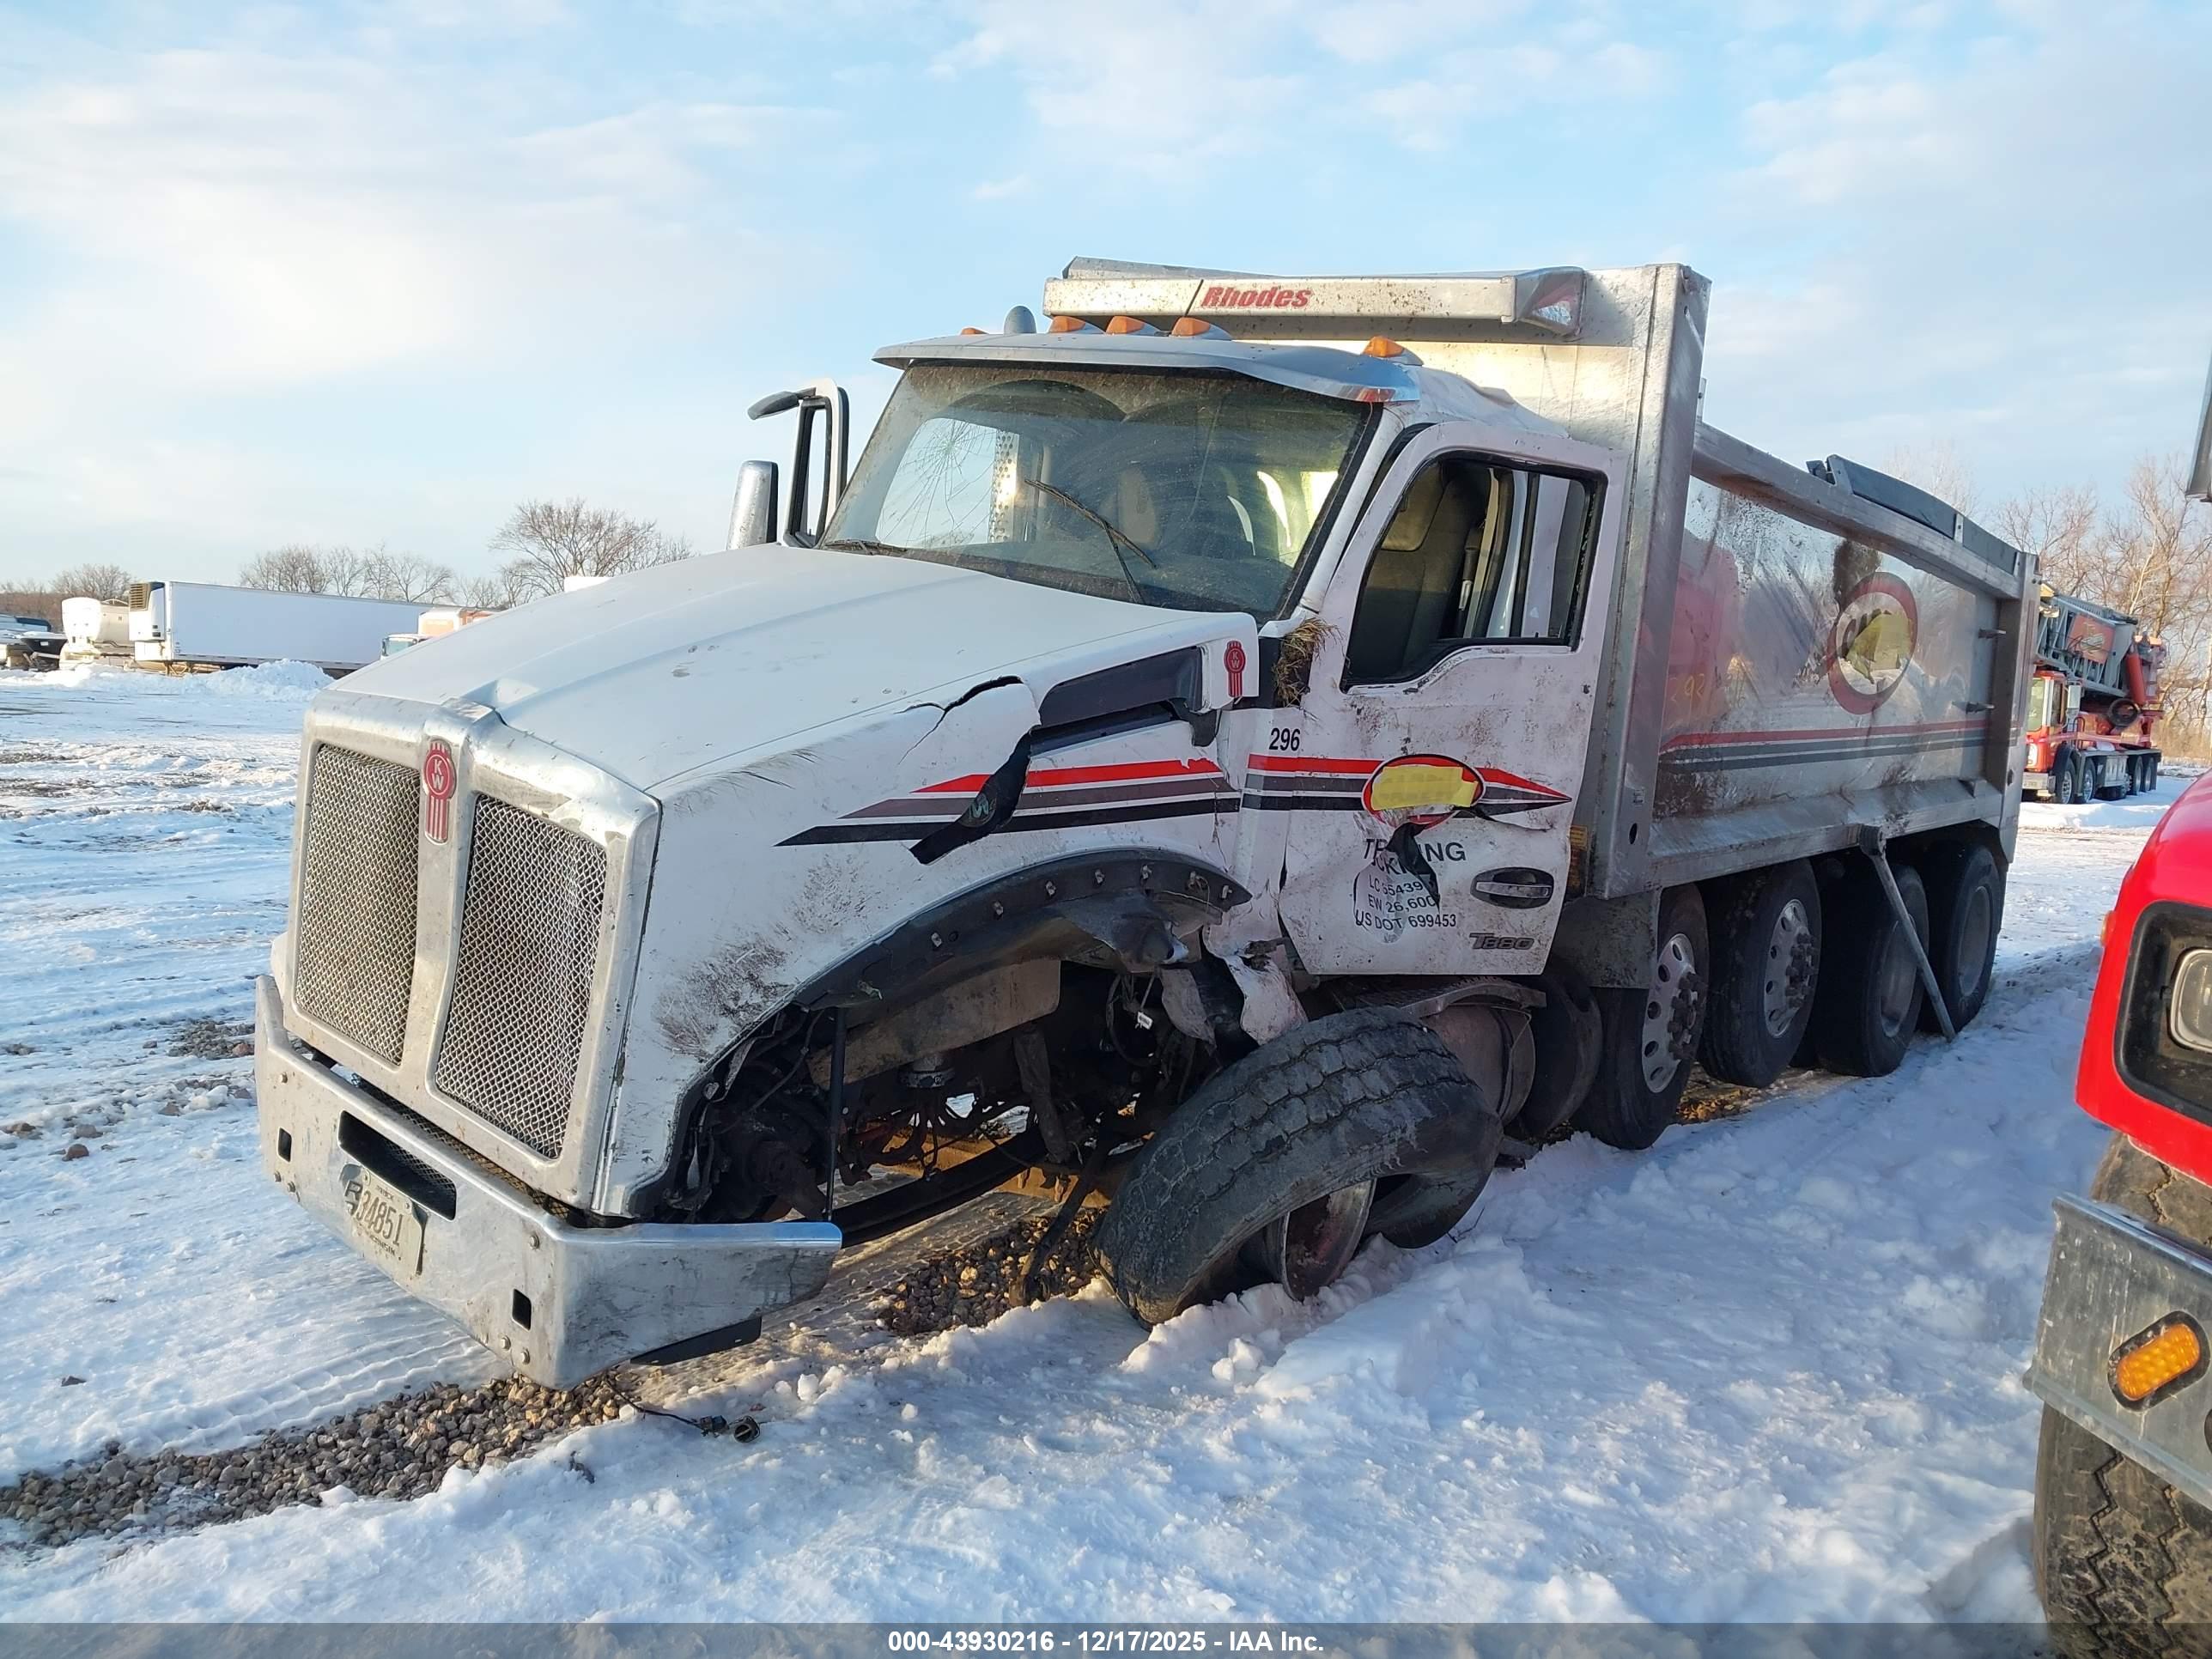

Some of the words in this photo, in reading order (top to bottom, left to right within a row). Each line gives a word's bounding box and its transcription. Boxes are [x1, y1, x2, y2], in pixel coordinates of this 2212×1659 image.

[1200, 286, 1312, 307] Rhodes
[1268, 727, 1301, 751] 296
[1369, 874, 1381, 893] LC
[1368, 894, 1382, 912] EW
[1355, 908, 1372, 927] US
[1375, 916, 1402, 931] DOT
[1408, 914, 1456, 928] 699453
[1469, 933, 1534, 951] T880
[356, 1190, 404, 1247] 34851
